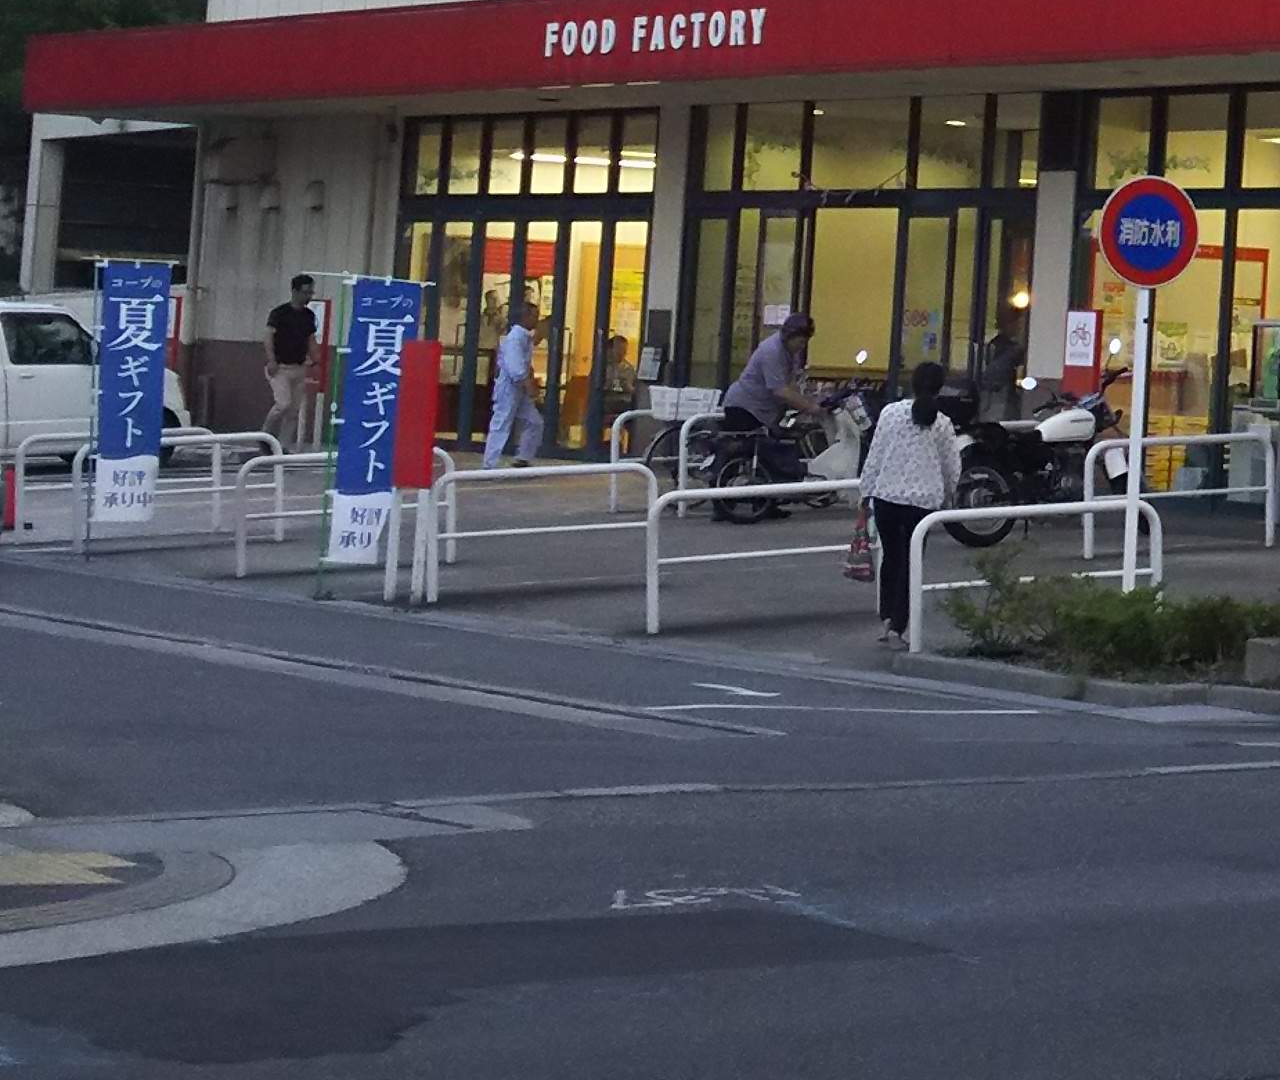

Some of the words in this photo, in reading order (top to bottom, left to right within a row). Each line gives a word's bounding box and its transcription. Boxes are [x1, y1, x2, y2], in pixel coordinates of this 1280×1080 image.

[544, 18, 616, 57] FOOD
[632, 8, 768, 52] FACTORY
[1119, 217, 1180, 248] 消防水利
[111, 276, 163, 288] コープの
[360, 294, 414, 309] コープの
[106, 293, 165, 448] 夏ギフト
[353, 314, 415, 483] 夏ギフト
